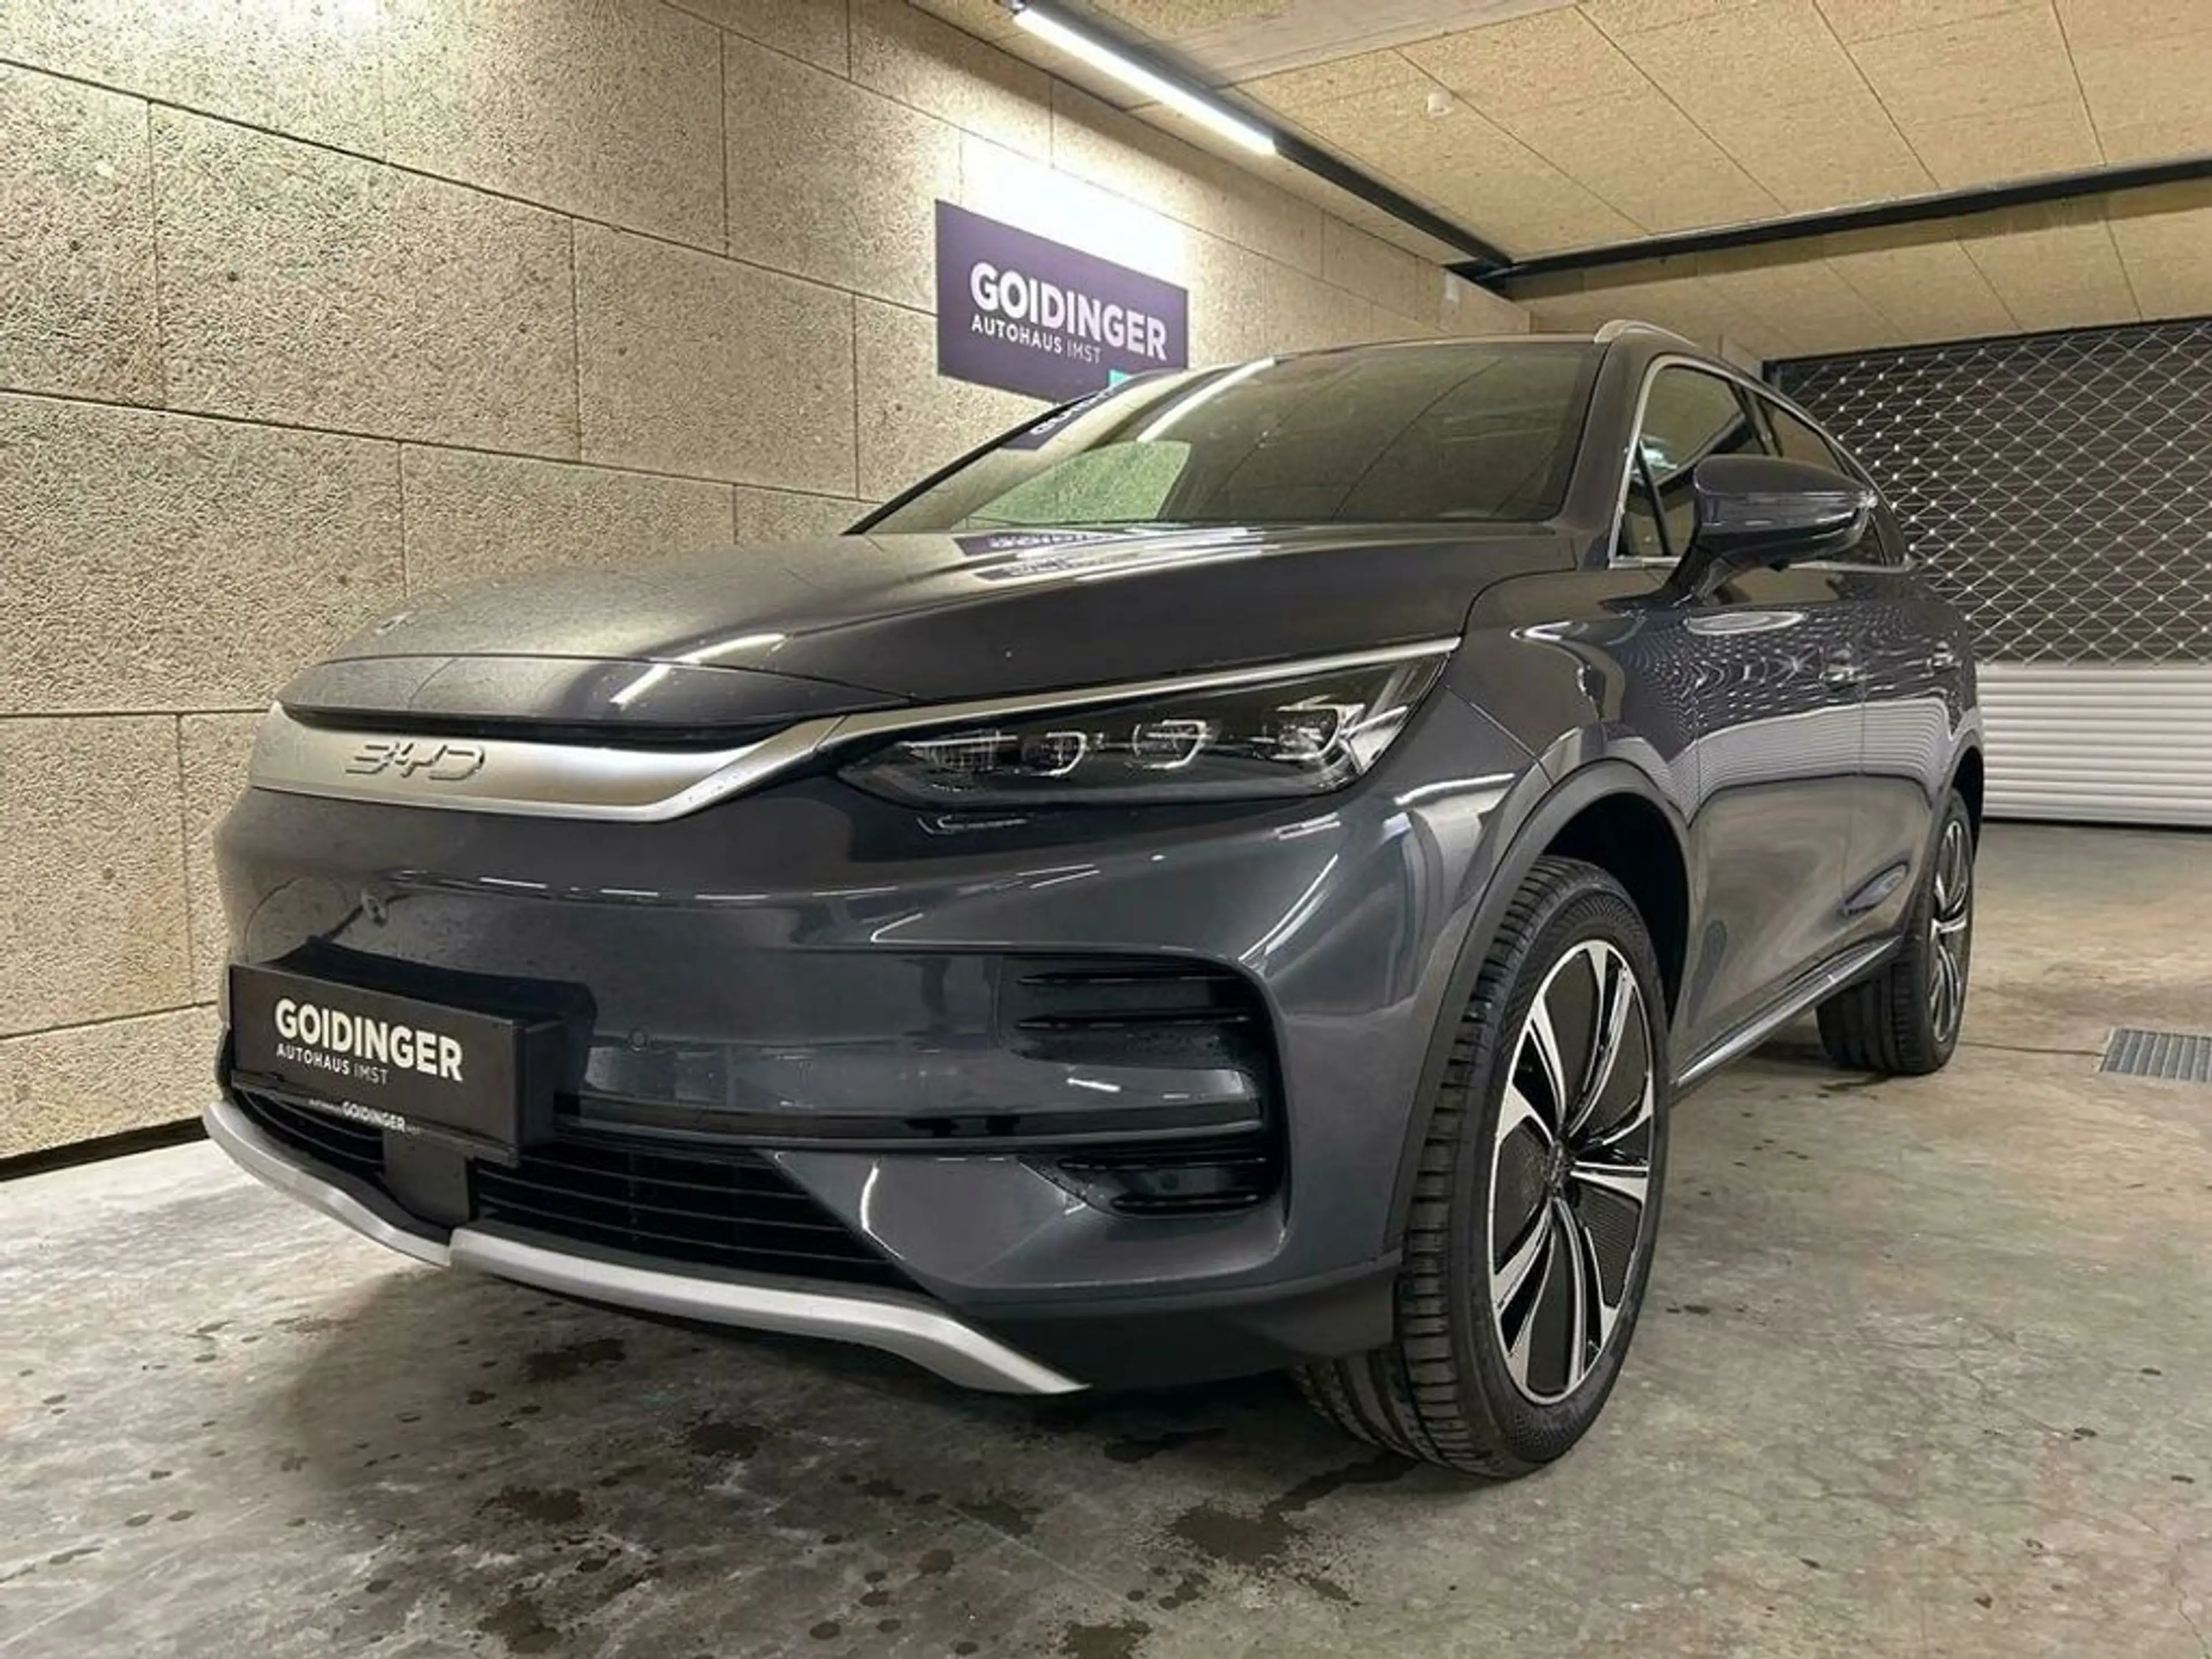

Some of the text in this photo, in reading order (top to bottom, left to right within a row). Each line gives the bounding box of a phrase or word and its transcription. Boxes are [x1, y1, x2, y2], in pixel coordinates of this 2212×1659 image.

[970, 262, 1167, 361] GOIDINGER
[971, 315, 1101, 364] AUTOHAUS IMST
[275, 998, 463, 1081] GOIDINGER
[276, 1043, 388, 1085] AUTOHAUS IMST
